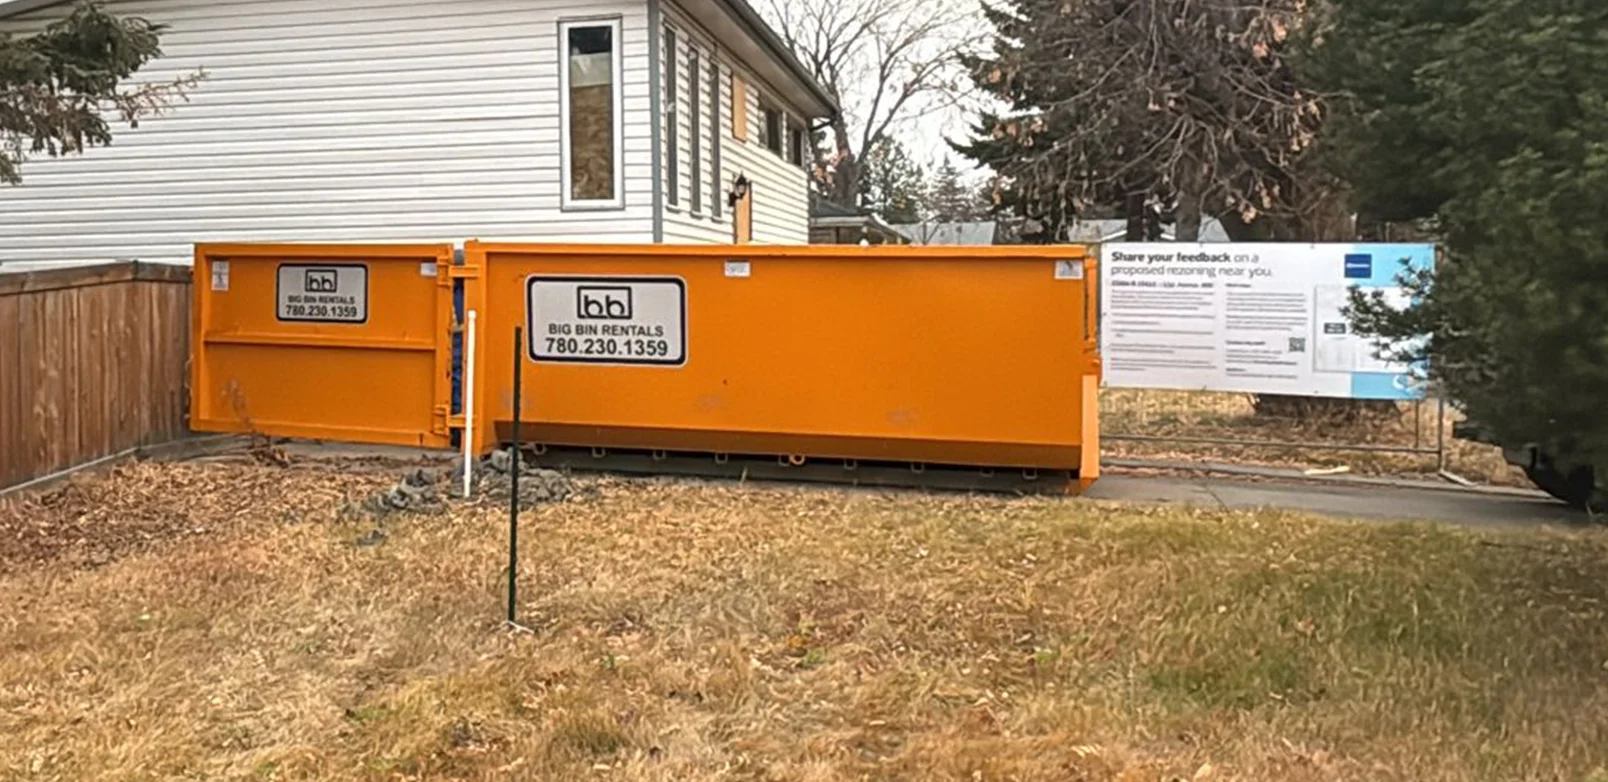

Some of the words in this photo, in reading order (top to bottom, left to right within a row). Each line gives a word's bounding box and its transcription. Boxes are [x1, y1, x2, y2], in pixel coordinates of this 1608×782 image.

[1111, 251, 1145, 262] Share
[1147, 254, 1174, 264] your
[1177, 251, 1231, 262] feedback
[1234, 254, 1250, 263] on
[1251, 253, 1260, 263] a
[1111, 265, 1165, 277] proposed
[1167, 266, 1217, 278] rezoning
[1219, 267, 1245, 276] near
[319, 296, 355, 304] RENTALS
[286, 305, 357, 317] 780.230.1359
[548, 323, 572, 335] BIG
[575, 324, 598, 335] BIN
[601, 324, 664, 337] RENTALS
[545, 337, 668, 356] 780.230.1359
